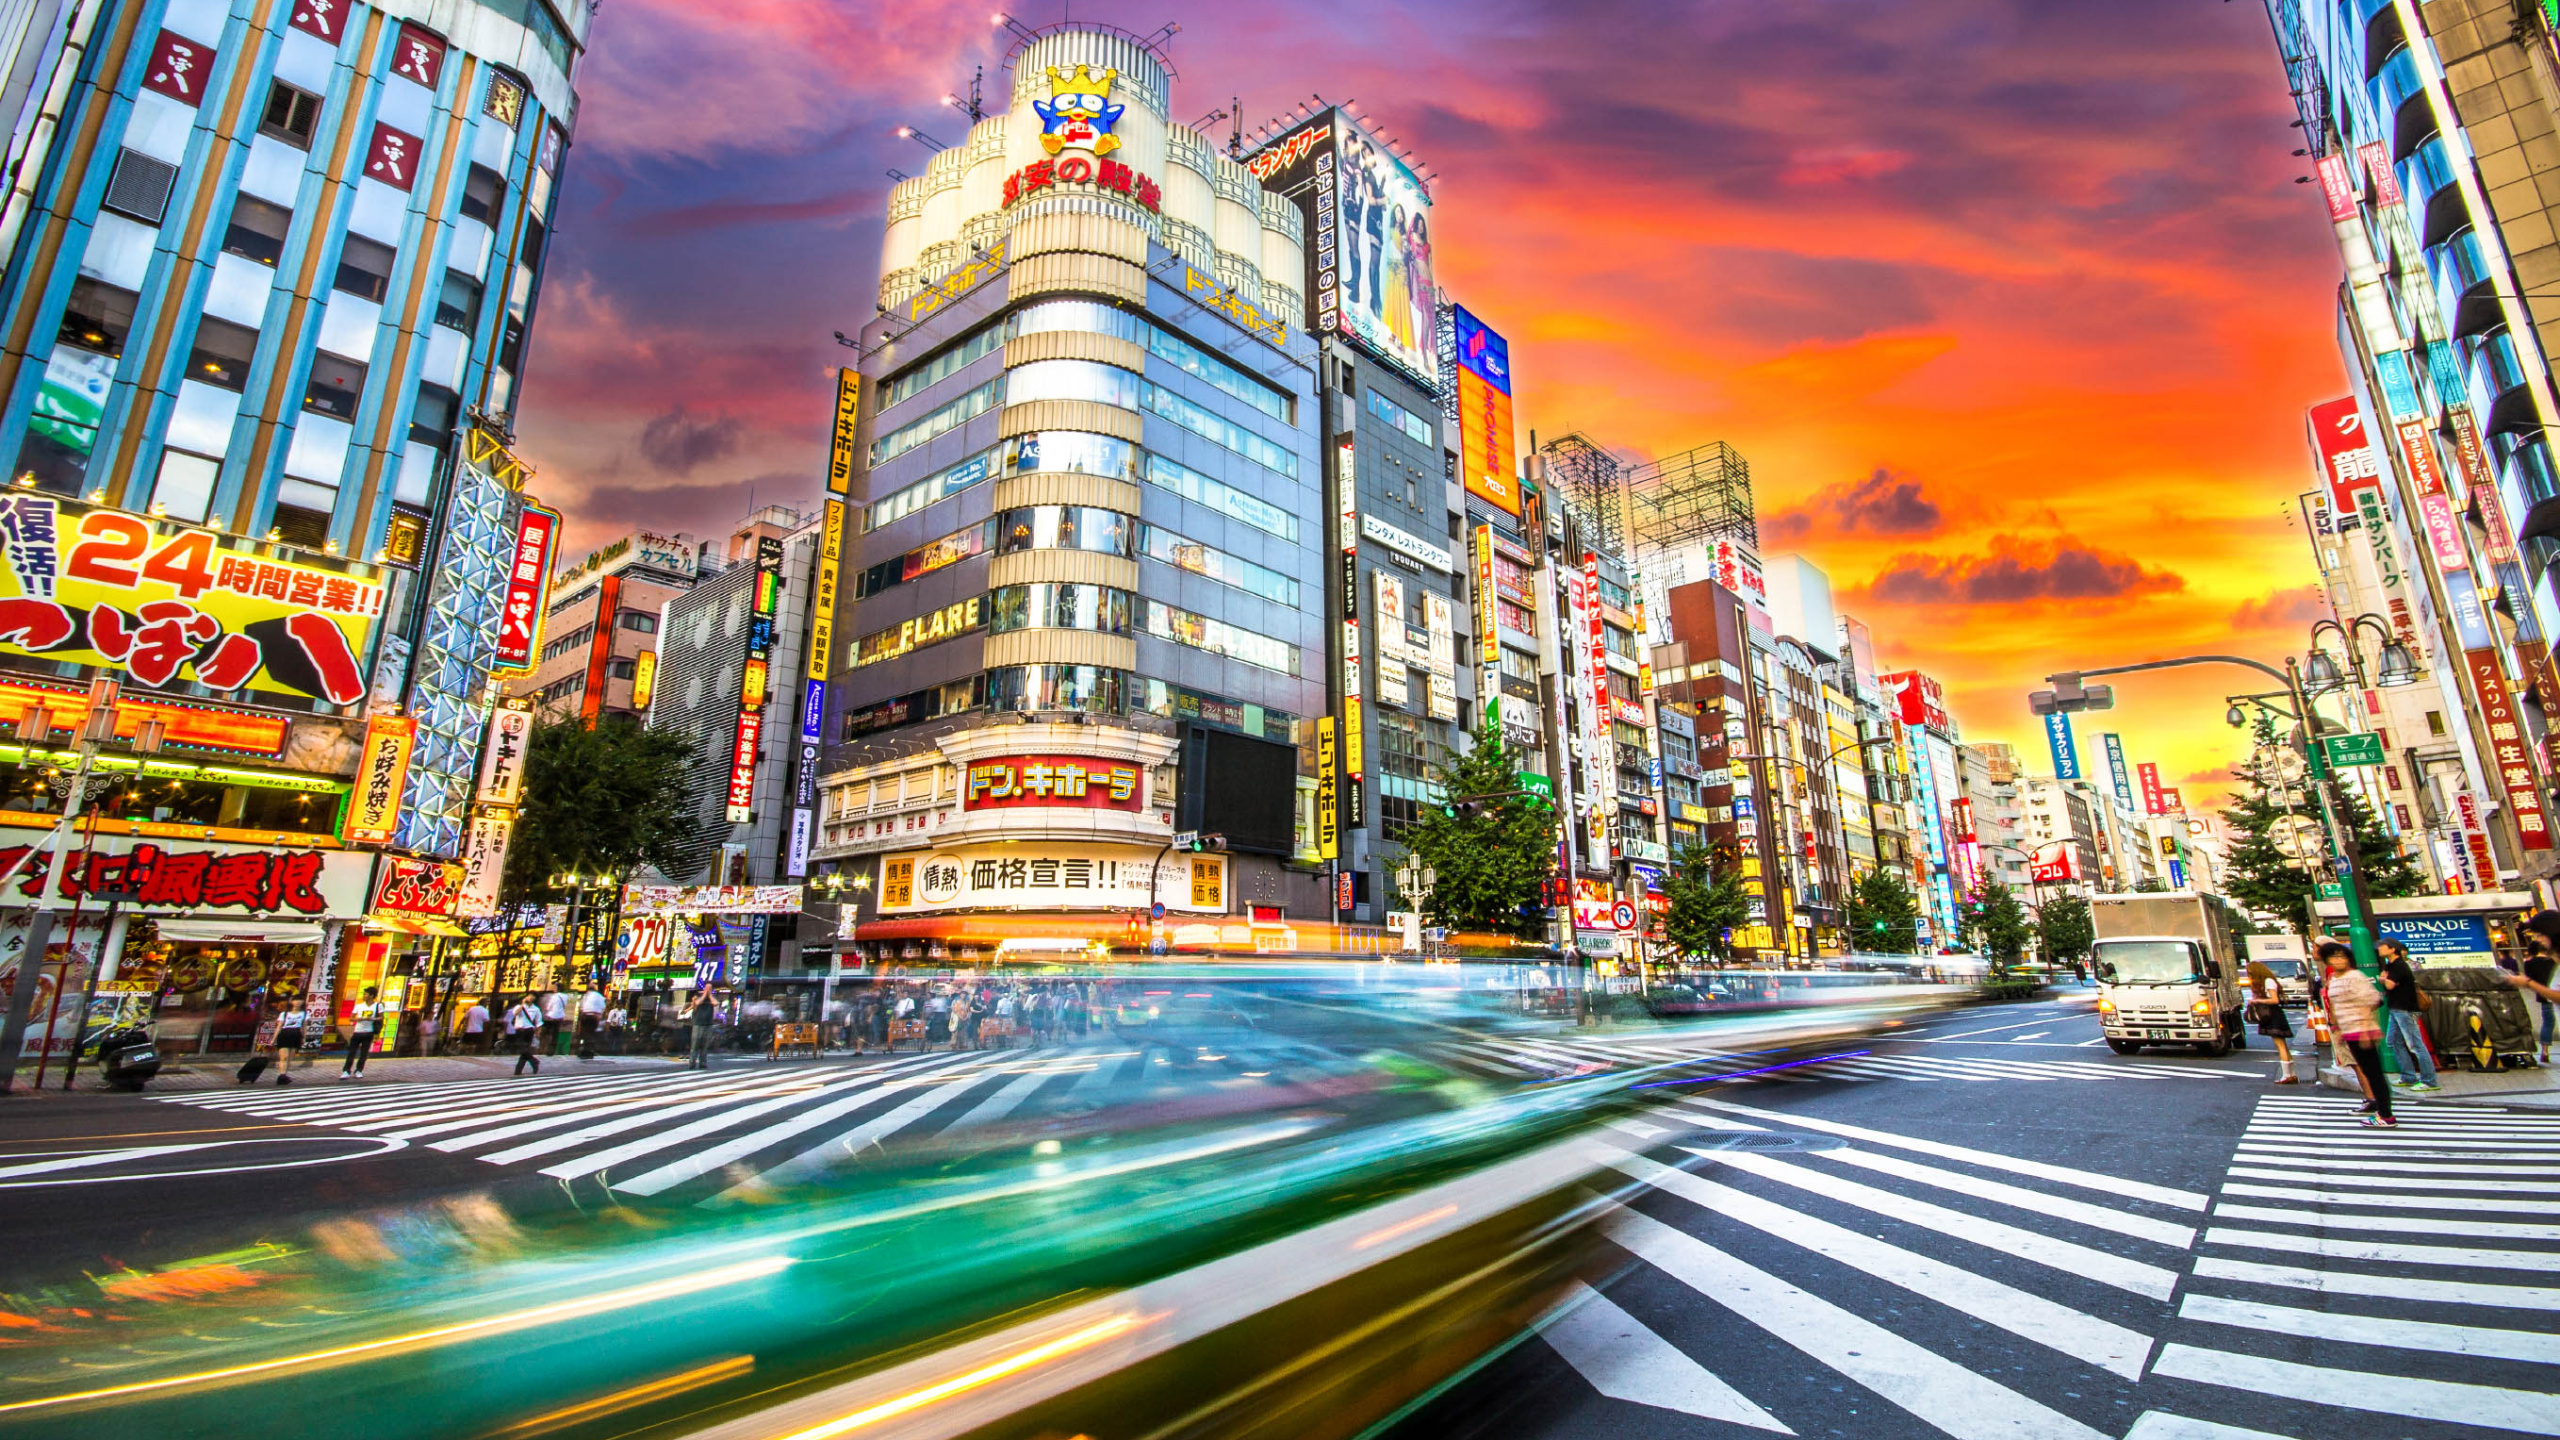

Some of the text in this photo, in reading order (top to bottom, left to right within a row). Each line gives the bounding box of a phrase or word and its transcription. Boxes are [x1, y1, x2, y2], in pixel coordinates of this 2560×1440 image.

[154, 43, 190, 95] つぼ八
[412, 41, 429, 83] つぼ八
[372, 134, 404, 180] つぼ八
[1002, 158, 1162, 215] 激安の殿堂
[1314, 150, 1338, 331] 進化型居酒屋の聖地
[1483, 384, 1499, 476] PROMISE
[1484, 476, 1506, 498] プロミス
[825, 505, 842, 557] ブランド品
[1366, 519, 1396, 540] エンタメ
[1398, 533, 1451, 565] レストランタワー
[2358, 493, 2400, 589] 新宿サンパーク
[513, 526, 544, 582] 居酒屋
[638, 548, 695, 573] カプセル
[819, 569, 834, 608] 貴金属
[501, 591, 531, 639] つぼ八
[899, 597, 979, 650] FLARE
[1585, 561, 1606, 691] カラオケ パセラ
[812, 624, 828, 674] 高額買取
[506, 699, 528, 711] 6F
[1180, 693, 1200, 712] 販売
[1578, 616, 1600, 798] カラオケ パセラ
[2333, 736, 2373, 750] モア
[2478, 665, 2546, 833] クスリの龍生堂薬局
[362, 736, 399, 827] お好み焼き
[1651, 759, 1662, 788] 747
[484, 809, 508, 819] 5F
[886, 863, 912, 880] 情熱
[923, 864, 959, 892] 情熱
[970, 858, 1117, 891] 価格宣言!!
[1193, 863, 1220, 880] 情熱
[2032, 866, 2064, 880] アコム
[886, 884, 911, 904] 価格
[1193, 884, 1220, 903] 価格
[629, 918, 668, 966] 270
[749, 915, 766, 967] カラオケ
[2380, 918, 2471, 935] SUBNADE
[693, 961, 718, 982] 747
[730, 943, 745, 986] カラオケ
